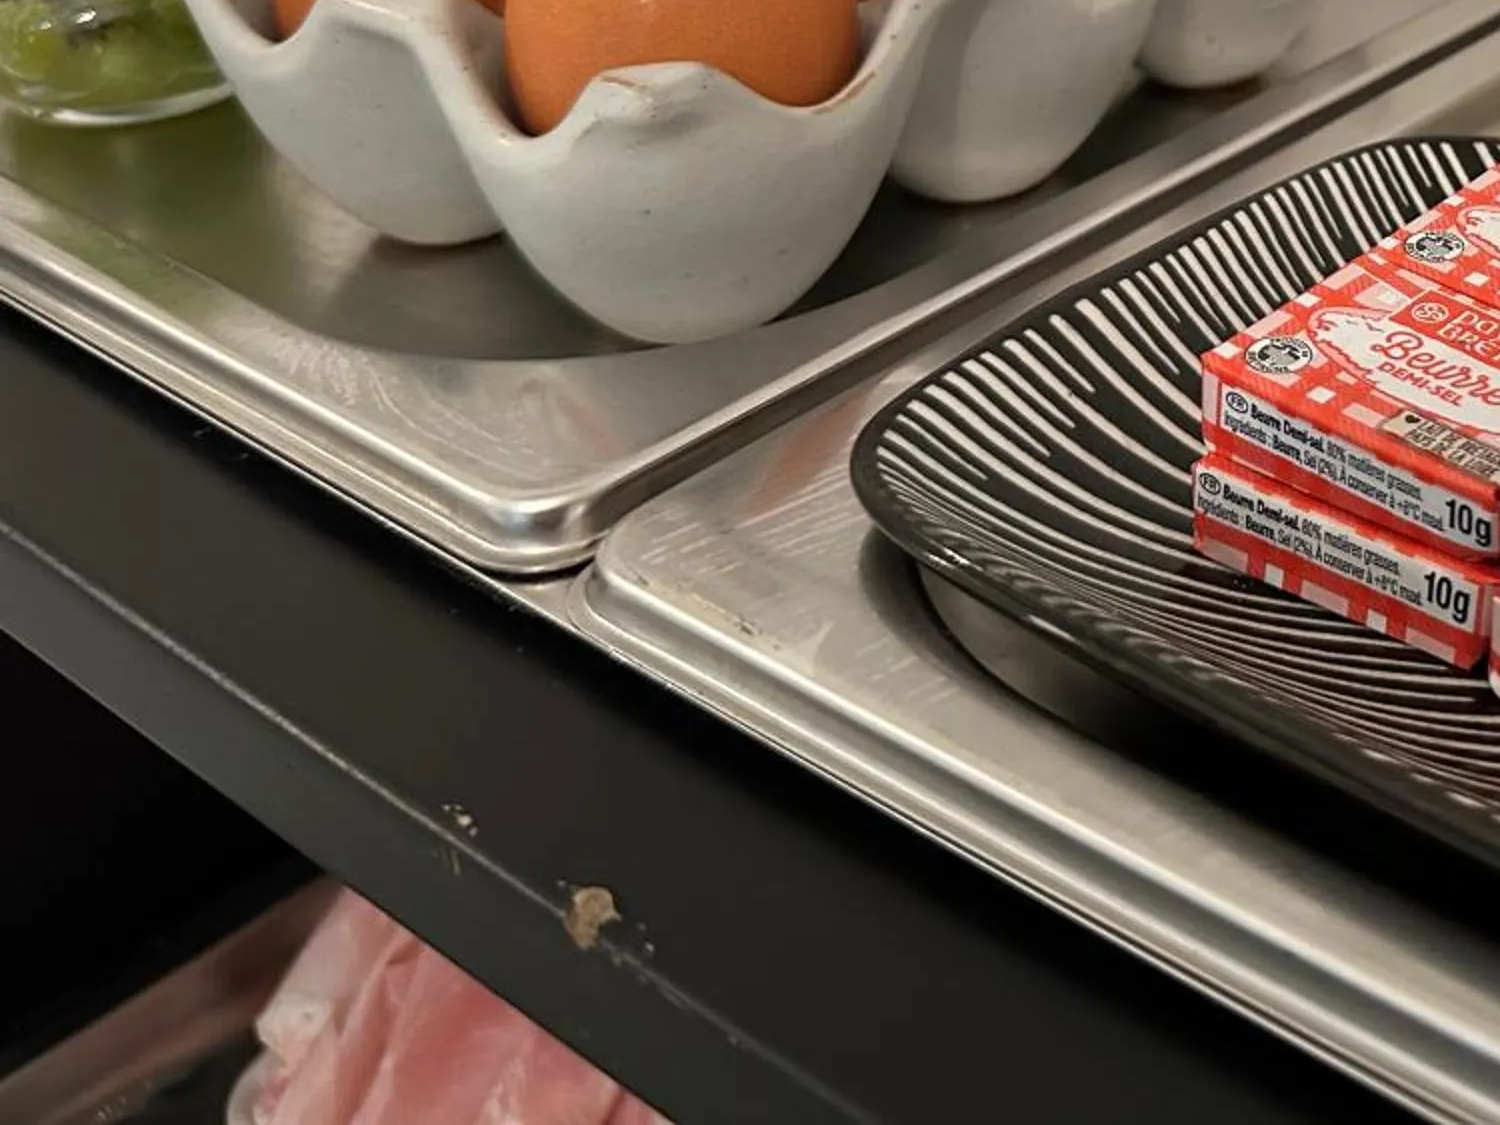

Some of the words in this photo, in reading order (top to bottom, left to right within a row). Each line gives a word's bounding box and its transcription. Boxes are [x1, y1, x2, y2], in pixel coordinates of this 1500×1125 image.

[1372, 360, 1472, 407] DEMI-SEL
[1223, 483, 1254, 512] Beurre
[1444, 495, 1491, 549] 10g
[1421, 567, 1471, 627] 10g
